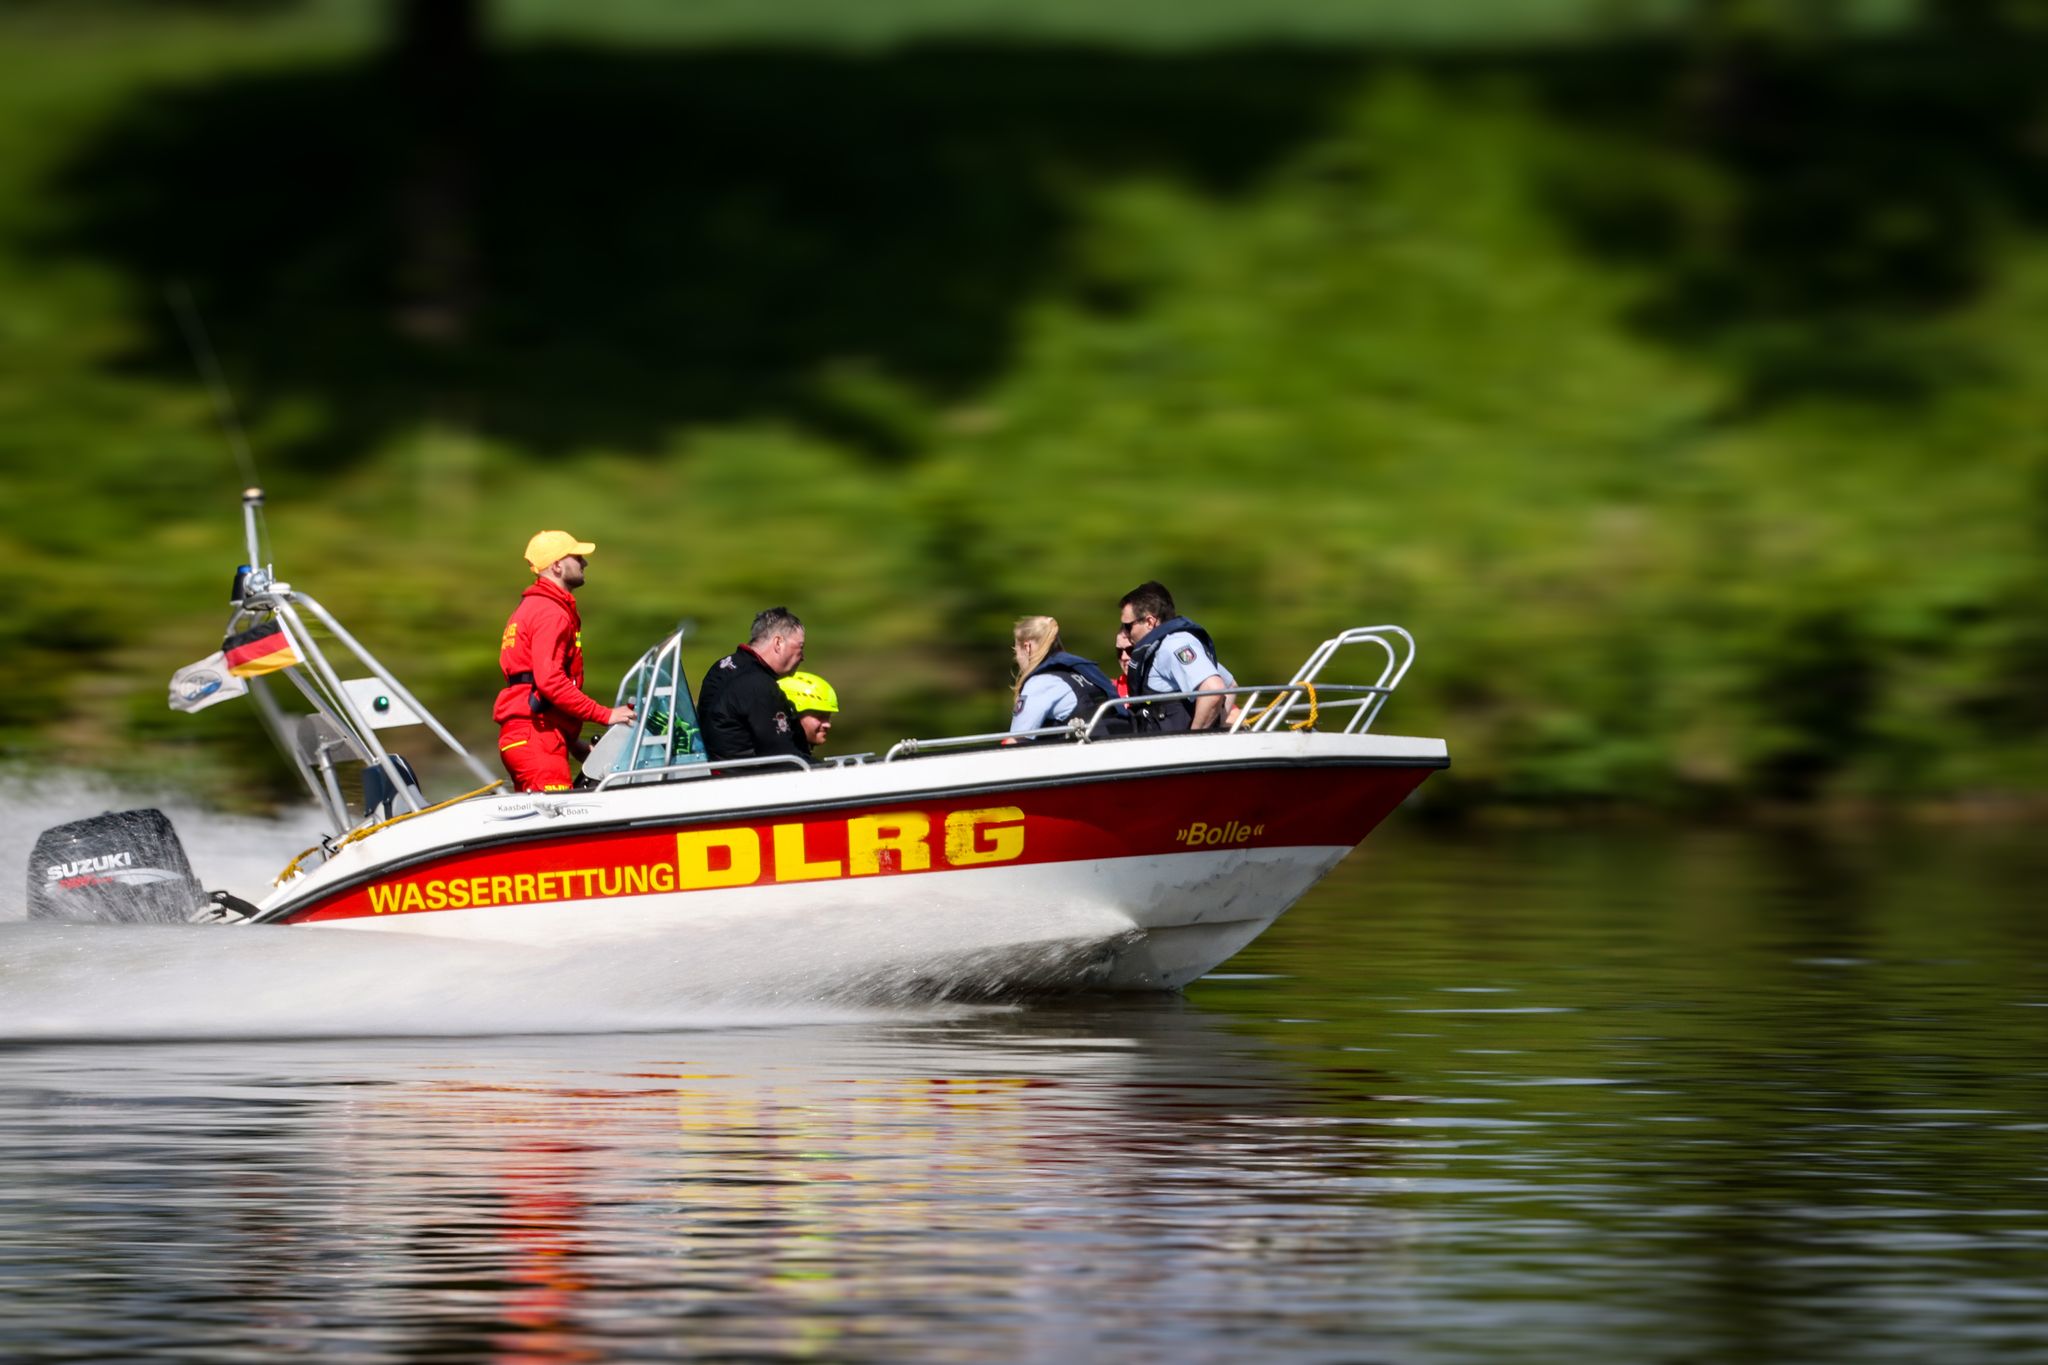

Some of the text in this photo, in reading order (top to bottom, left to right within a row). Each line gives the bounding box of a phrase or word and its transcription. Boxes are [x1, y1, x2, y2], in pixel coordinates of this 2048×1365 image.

[47, 852, 132, 880] SUZUKI
[676, 806, 1025, 890] DLRG
[368, 862, 674, 914] WASSERRETTUNG
